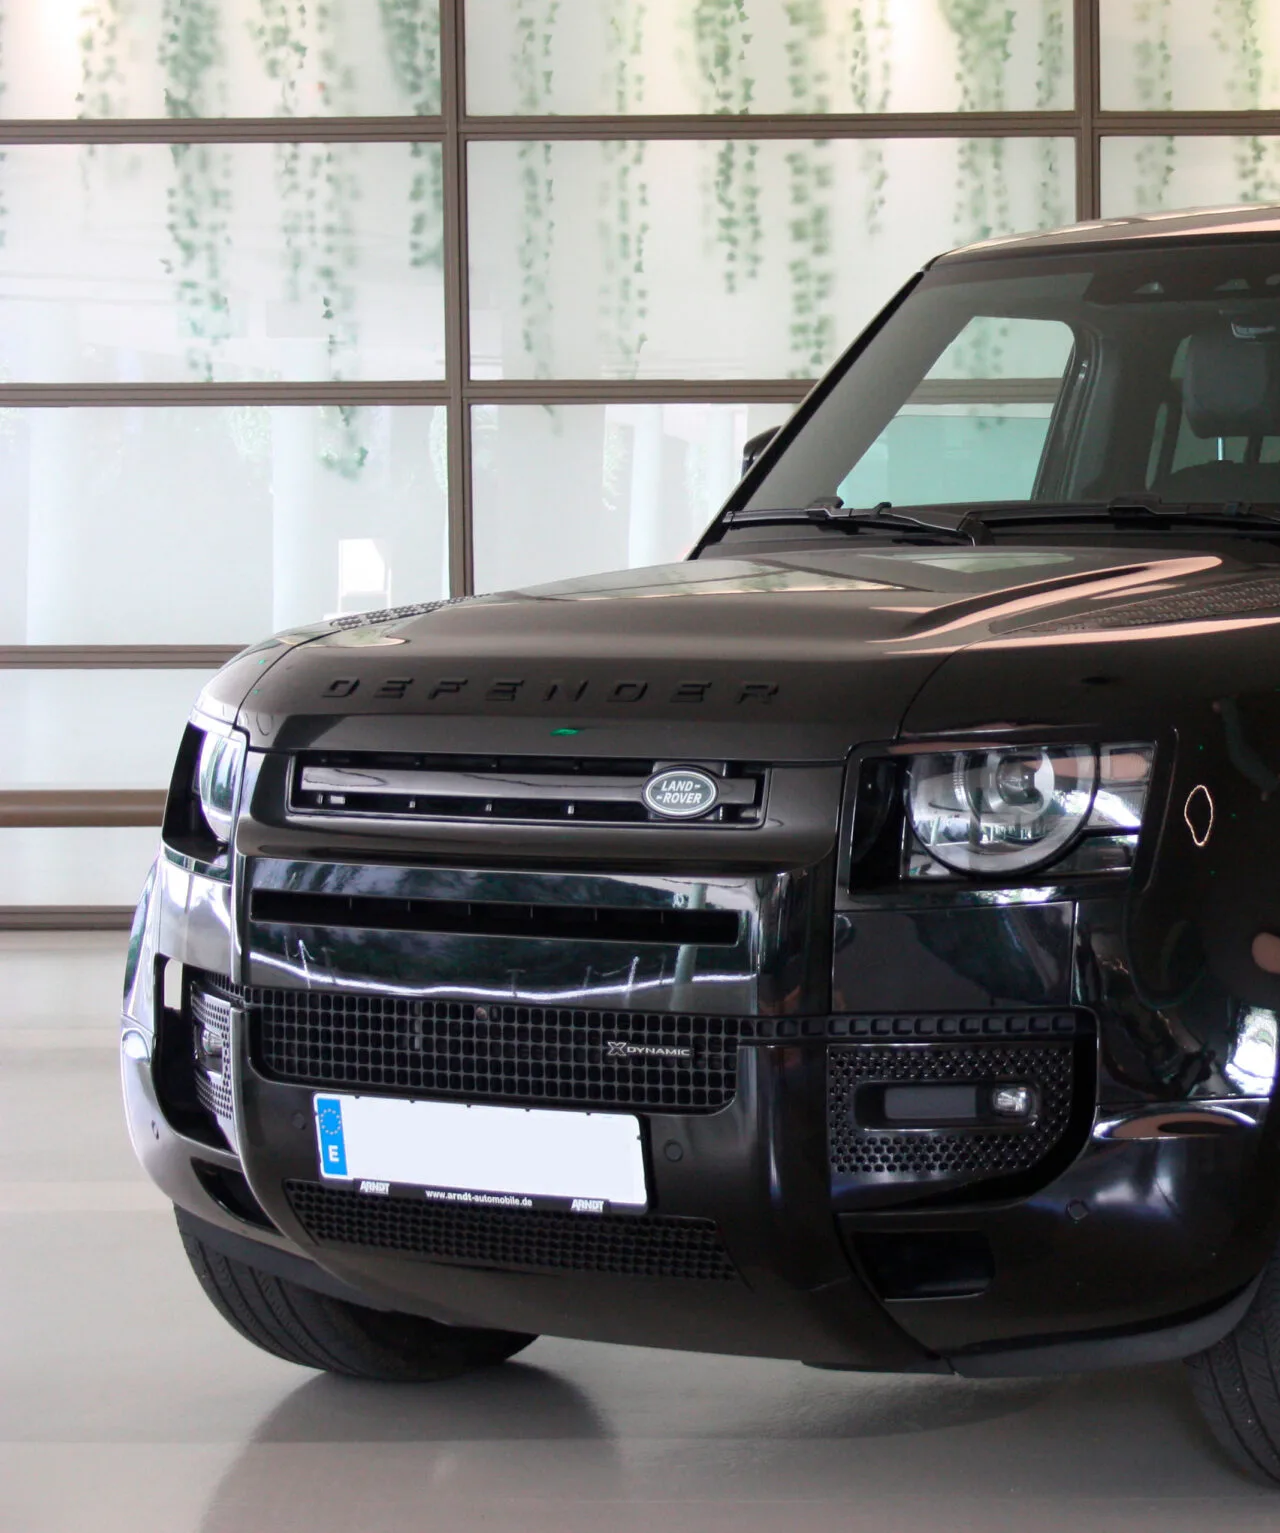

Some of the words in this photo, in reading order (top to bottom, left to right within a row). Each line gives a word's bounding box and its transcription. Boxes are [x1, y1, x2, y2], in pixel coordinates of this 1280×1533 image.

[322, 677, 779, 704] DEFENDER
[328, 1145, 340, 1162] E
[360, 1180, 390, 1195] ARNDT
[425, 1189, 533, 1207] www.arndt-automobile.de
[571, 1199, 604, 1212] ARNDT
